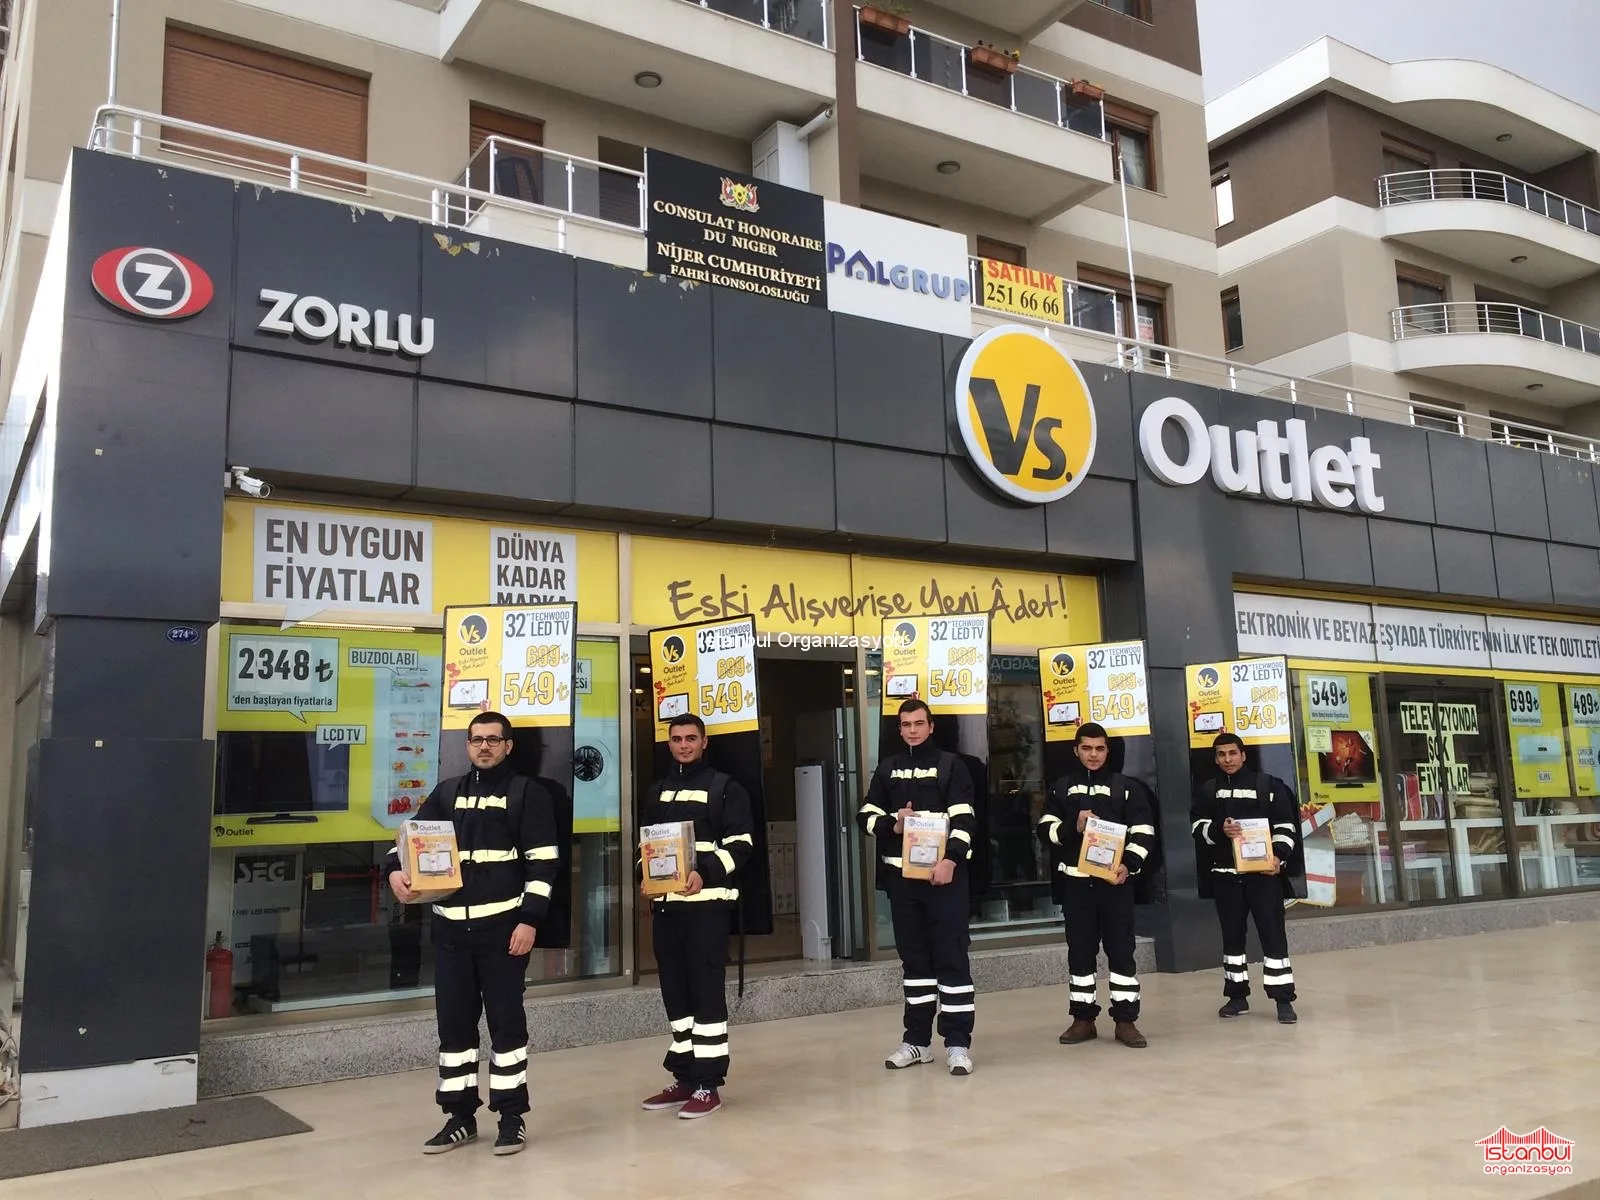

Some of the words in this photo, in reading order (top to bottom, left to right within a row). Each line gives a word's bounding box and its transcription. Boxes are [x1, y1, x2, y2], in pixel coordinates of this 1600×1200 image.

[653, 200, 735, 230] CONSULAT
[734, 220, 823, 252] HONORAIRE
[703, 228, 727, 244] DU
[731, 235, 778, 258] NIGER
[656, 242, 706, 265] NİJER
[708, 254, 822, 291] CUMHURİYETİ
[987, 259, 1058, 293] SATILIK
[670, 264, 710, 282] FAHRİ
[711, 273, 810, 304] KONSOLOSLUĞU
[986, 282, 1013, 306] 251
[1020, 290, 1038, 311] 66
[1043, 297, 1059, 316] 66
[258, 288, 435, 357] ZORLU
[1139, 397, 1385, 513] Outlet
[266, 519, 308, 554] EN
[318, 523, 424, 563] UYGUN
[497, 533, 564, 563] DÜNYA
[265, 557, 420, 605] FİYATLAR
[497, 564, 566, 590] KADAR
[667, 573, 749, 621] Eski
[760, 582, 912, 627] Alışverişe
[920, 578, 980, 616] Yeni
[531, 611, 570, 620] TECHWOOD
[531, 621, 552, 637] LED
[555, 621, 570, 635] TV
[719, 624, 751, 637] TECHWOOD
[952, 627, 970, 640] LED
[971, 626, 984, 639] TV
[1236, 610, 1311, 639] EKTRONİK
[1313, 617, 1331, 641] VE
[1334, 619, 1378, 645] BEYAZ
[1381, 624, 1427, 651] EŞYADA
[1503, 628, 1522, 654] İLK
[1522, 634, 1536, 655] VE
[1537, 635, 1559, 657] TEK
[351, 650, 415, 666] BUZDOLABI
[459, 647, 487, 656] Outlet
[1110, 655, 1128, 667] LED
[1129, 653, 1141, 665] TV
[663, 664, 686, 674] Outlet
[1053, 677, 1076, 685] Outlet
[1253, 669, 1271, 681] LED
[1272, 668, 1284, 679] TV
[253, 695, 292, 707] başlayan
[293, 695, 333, 707] fiyatlarla
[1401, 704, 1478, 731] TELEVZYONDA
[323, 729, 345, 742] LCD
[347, 729, 361, 742] TV
[226, 828, 254, 836] Outlet
